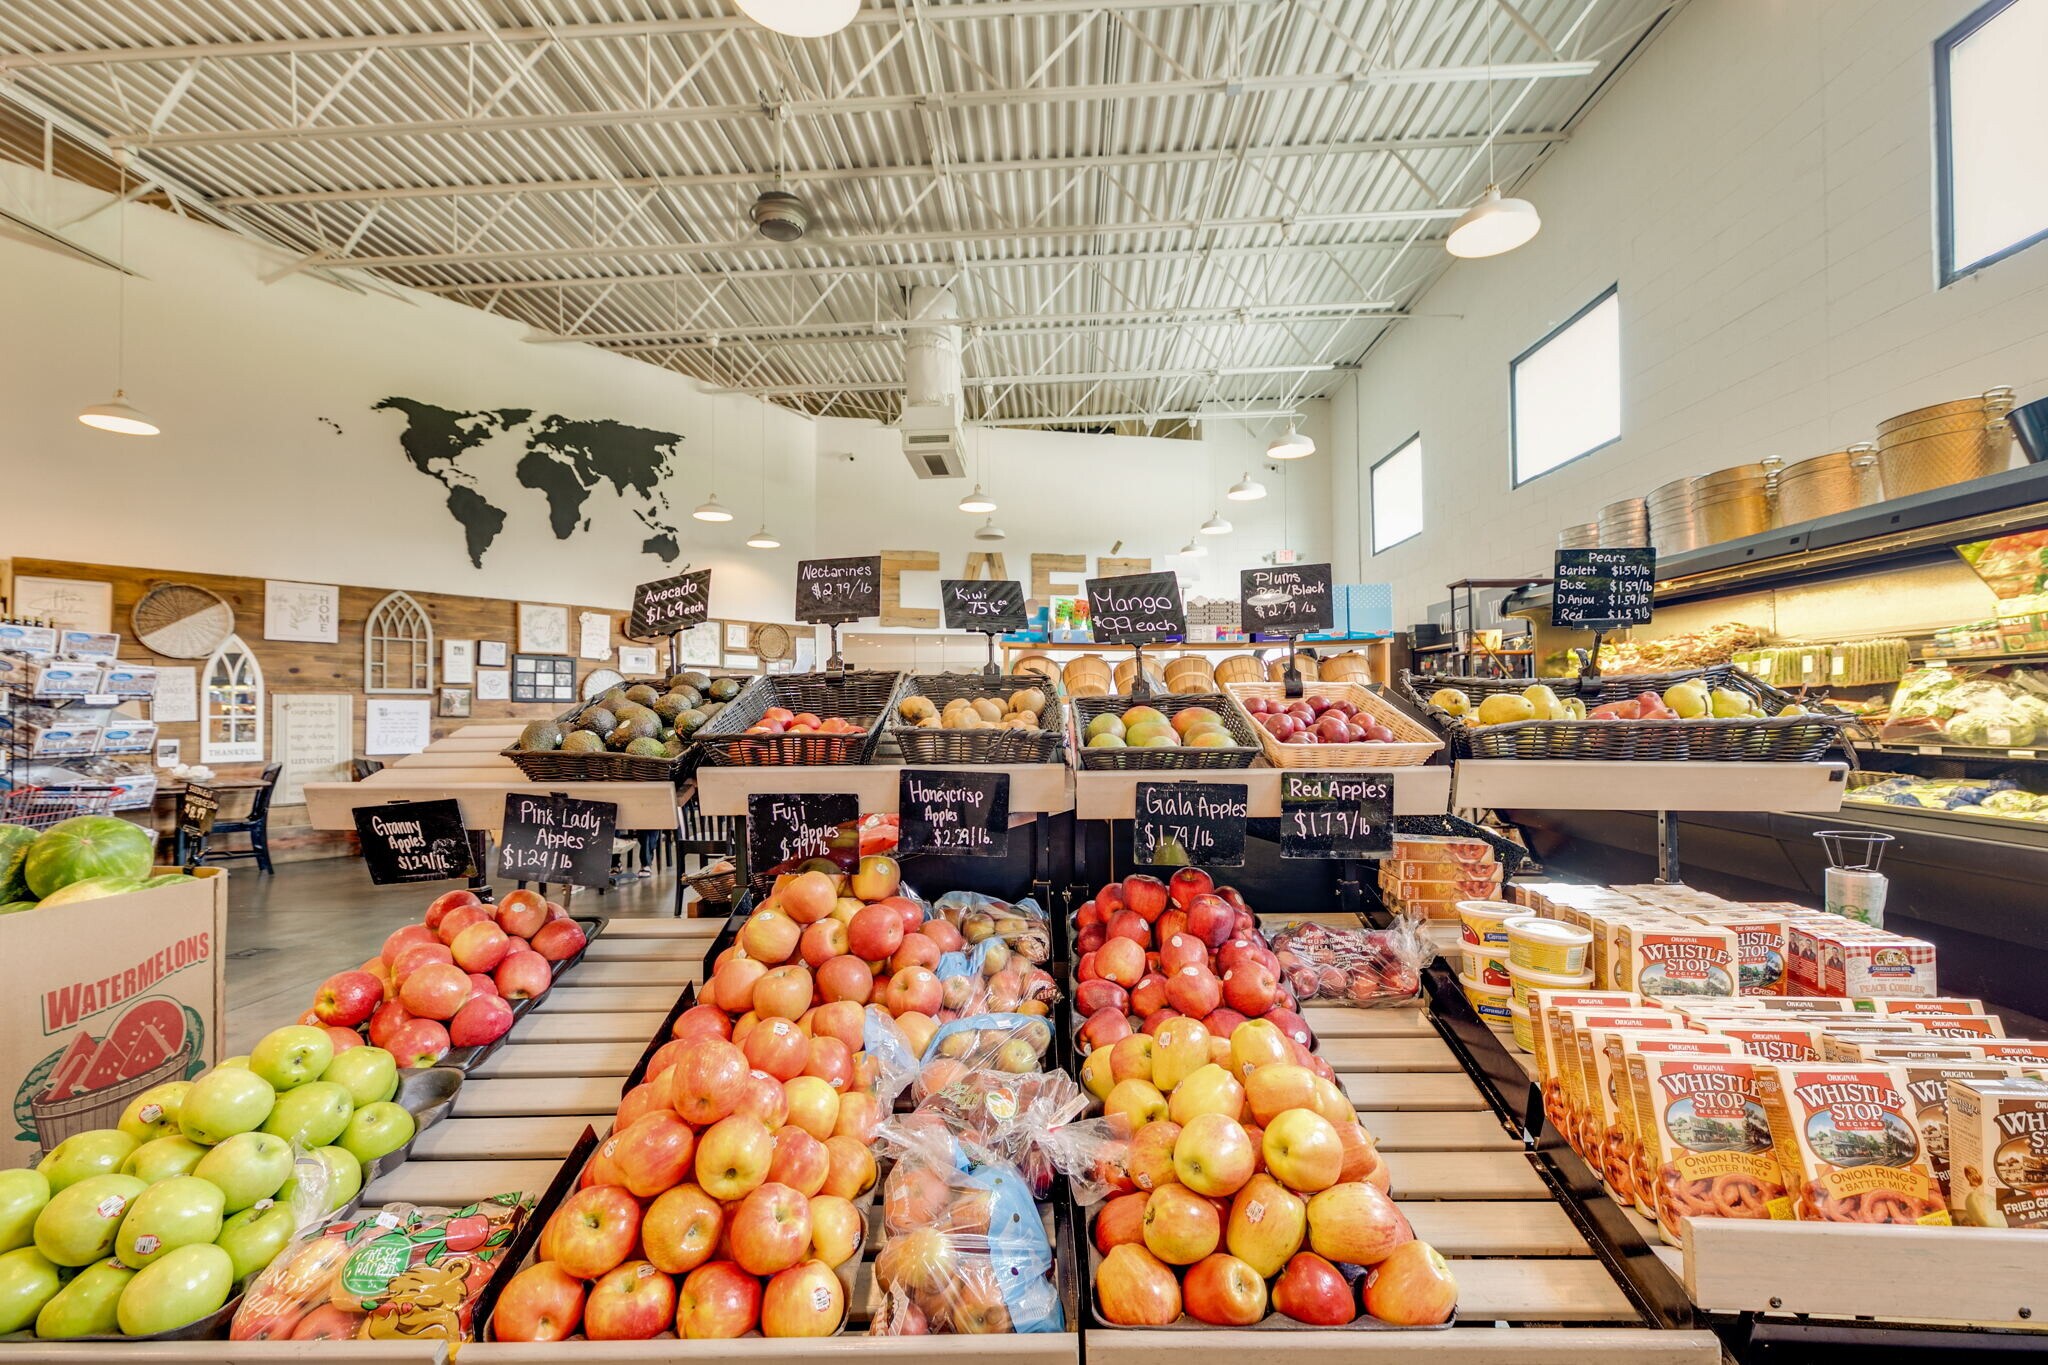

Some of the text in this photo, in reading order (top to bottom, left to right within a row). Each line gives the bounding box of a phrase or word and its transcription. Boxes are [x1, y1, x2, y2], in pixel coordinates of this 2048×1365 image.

[1588, 552, 1626, 563] Pears
[802, 565, 872, 580] Nectarines
[1559, 563, 1650, 577] Barlett $1.59/lb
[1253, 572, 1301, 585] Plums
[1560, 579, 1653, 594] Bosc $1.59/lb
[955, 588, 987, 601] Kiwi
[1093, 588, 1172, 614] Mango
[1560, 608, 1583, 621] Red
[1135, 619, 1178, 632] each
[209, 747, 257, 757] THANKFUL
[291, 754, 335, 765] unwind
[909, 779, 984, 808] Honeycrisp
[1289, 777, 1387, 801] Red Apples
[1146, 786, 1247, 820] Gala Apples
[521, 801, 600, 836] Pink Lady
[772, 801, 805, 832] Fuji
[925, 805, 958, 827] Apples
[372, 815, 423, 838] Granny
[1294, 809, 1371, 840] $1.79/lb
[536, 828, 584, 849] Apples
[800, 823, 839, 844] Apples
[388, 835, 426, 853] Apples
[1487, 933, 1508, 941] Caram
[1737, 932, 1783, 949] HISTLE
[1642, 943, 1730, 965] WHISTLE
[1738, 945, 1769, 959] STOP
[1667, 958, 1711, 972] STOP
[47, 932, 209, 1030] WATERMELONS
[1859, 982, 1926, 994] PEACH COBBLER
[1752, 986, 1777, 996] CRISP
[1668, 1043, 1699, 1051] ORIGINAL
[1744, 1041, 1816, 1063] HISTLE
[2001, 1047, 2033, 1055] ORIGINAL
[1941, 1070, 1975, 1078] ORIGINAL
[1694, 1092, 1746, 1109] STOP
[1795, 1083, 1900, 1109] WHISTLE
[1832, 1103, 1884, 1121] STOP
[1684, 1152, 1772, 1170] ONION RINGS
[1699, 1164, 1760, 1176] BATTER MIX
[1830, 1167, 1918, 1185] ONION RINGS
[1845, 1179, 1908, 1192] BATTER MIX
[2003, 1200, 2035, 1214] FRIED
